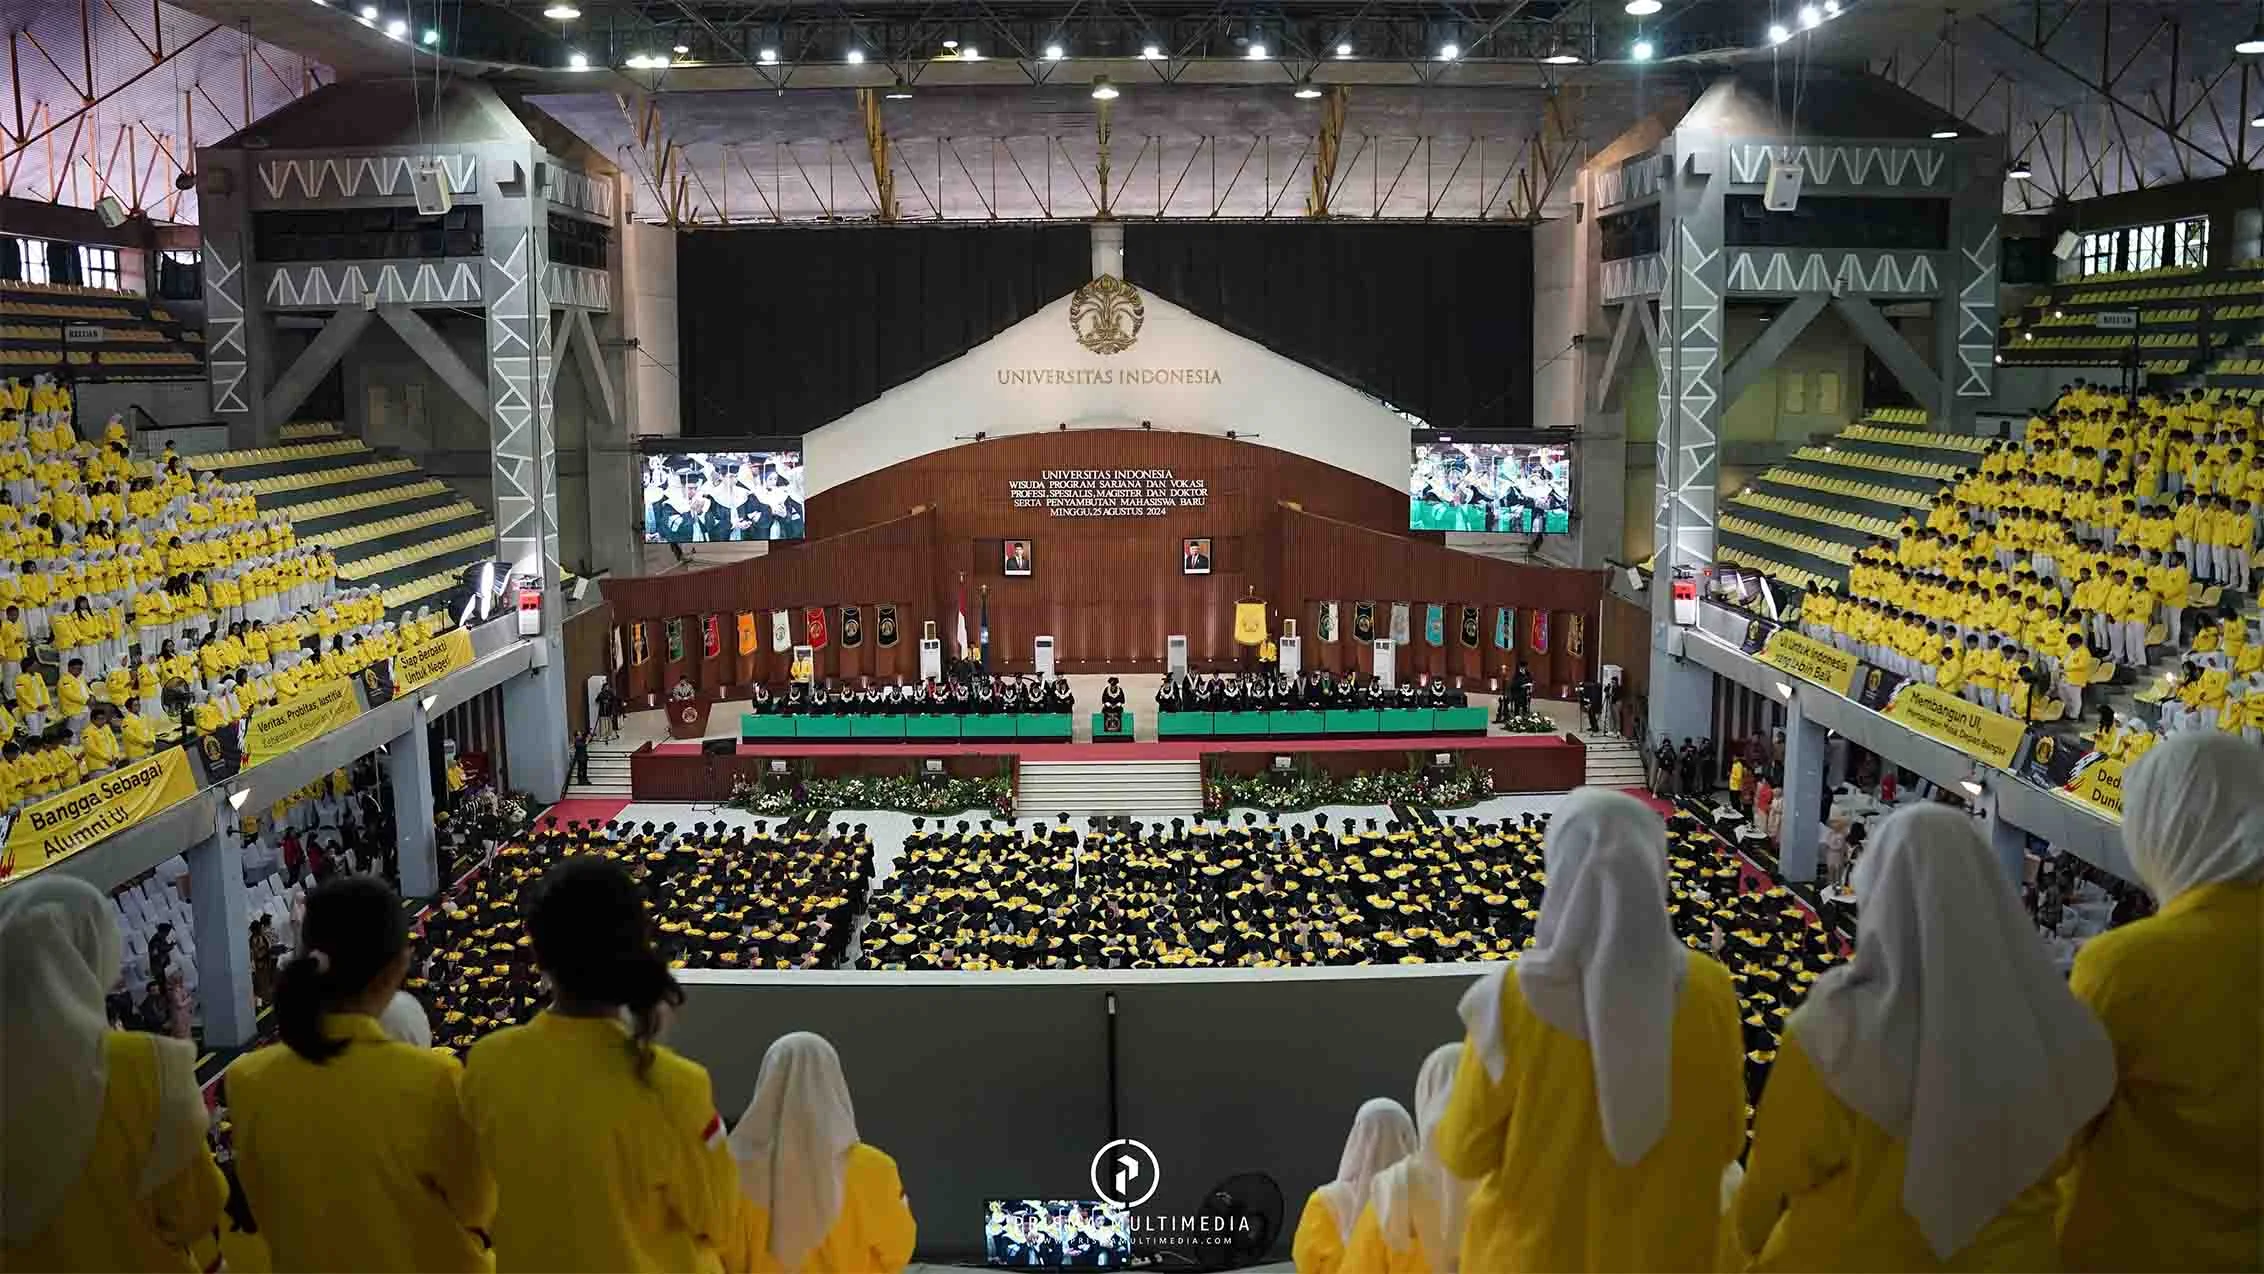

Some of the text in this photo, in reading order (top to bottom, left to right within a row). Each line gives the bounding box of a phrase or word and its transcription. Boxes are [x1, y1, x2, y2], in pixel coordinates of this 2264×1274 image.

[997, 368, 1222, 385] UNIVERSITAS INDONESIA
[1041, 469, 1173, 480] UNIVERSITAS INDONESIA
[1008, 480, 1204, 489] WISUDA PROGRAM SARJANA DAN VOKASI
[1096, 489, 1142, 498] MAGISTER
[1146, 489, 1166, 497] DAN
[1170, 488, 1208, 497] DOKTOR
[1013, 497, 1205, 507] SERTA PENYAMBUTAN MAHASISWA BARU
[1102, 507, 1143, 516] AGUSTUS
[1146, 507, 1166, 515] 2024
[400, 655, 418, 669] Siap
[405, 666, 428, 684] Untuk
[1910, 691, 1967, 725] Membangun
[2097, 767, 2123, 790] Ded
[29, 760, 164, 831] Bangga Sebagai
[43, 805, 129, 859] Alumni UI
